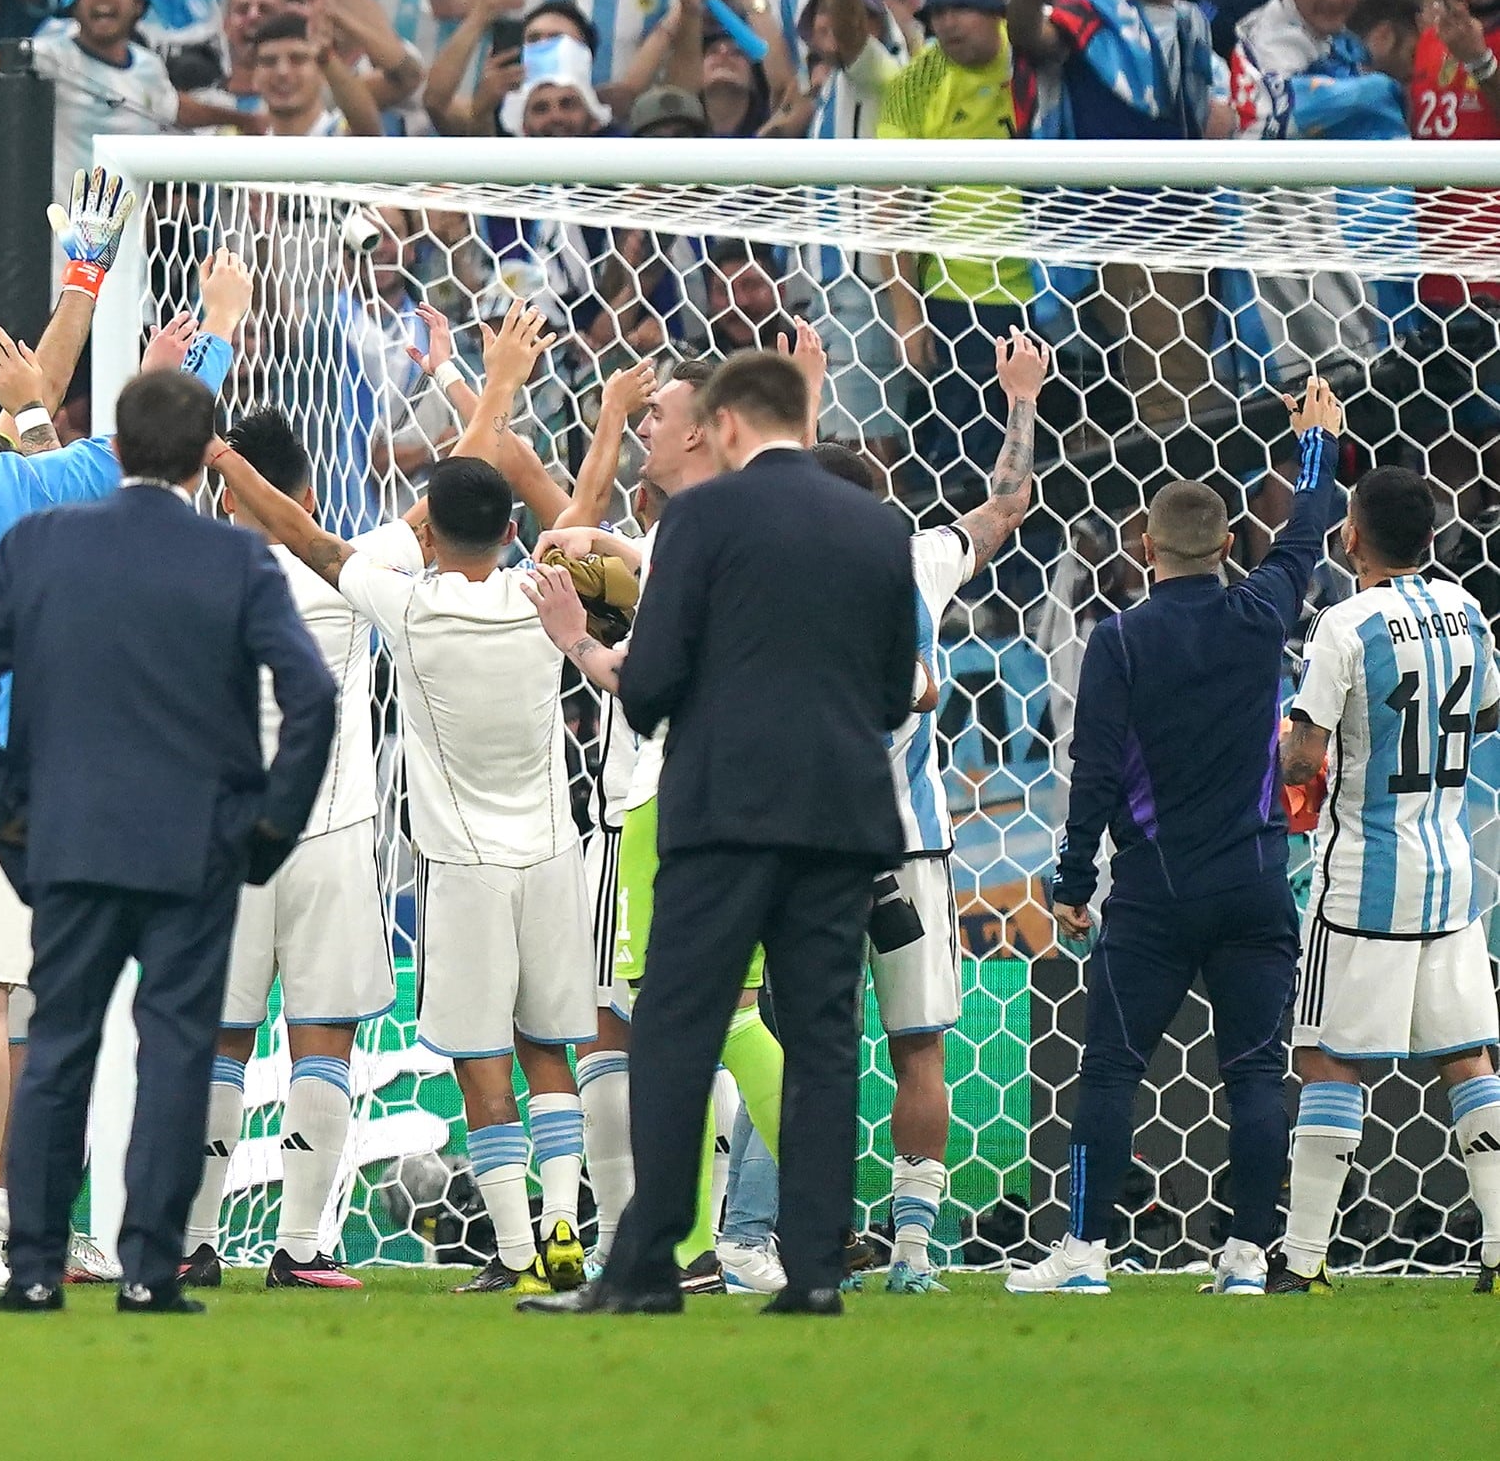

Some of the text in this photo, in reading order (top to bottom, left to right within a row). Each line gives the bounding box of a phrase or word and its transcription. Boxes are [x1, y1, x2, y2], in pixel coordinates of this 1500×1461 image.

[1418, 90, 1458, 137] 23
[1387, 610, 1470, 646] ALMADA
[1385, 665, 1474, 795] 16
